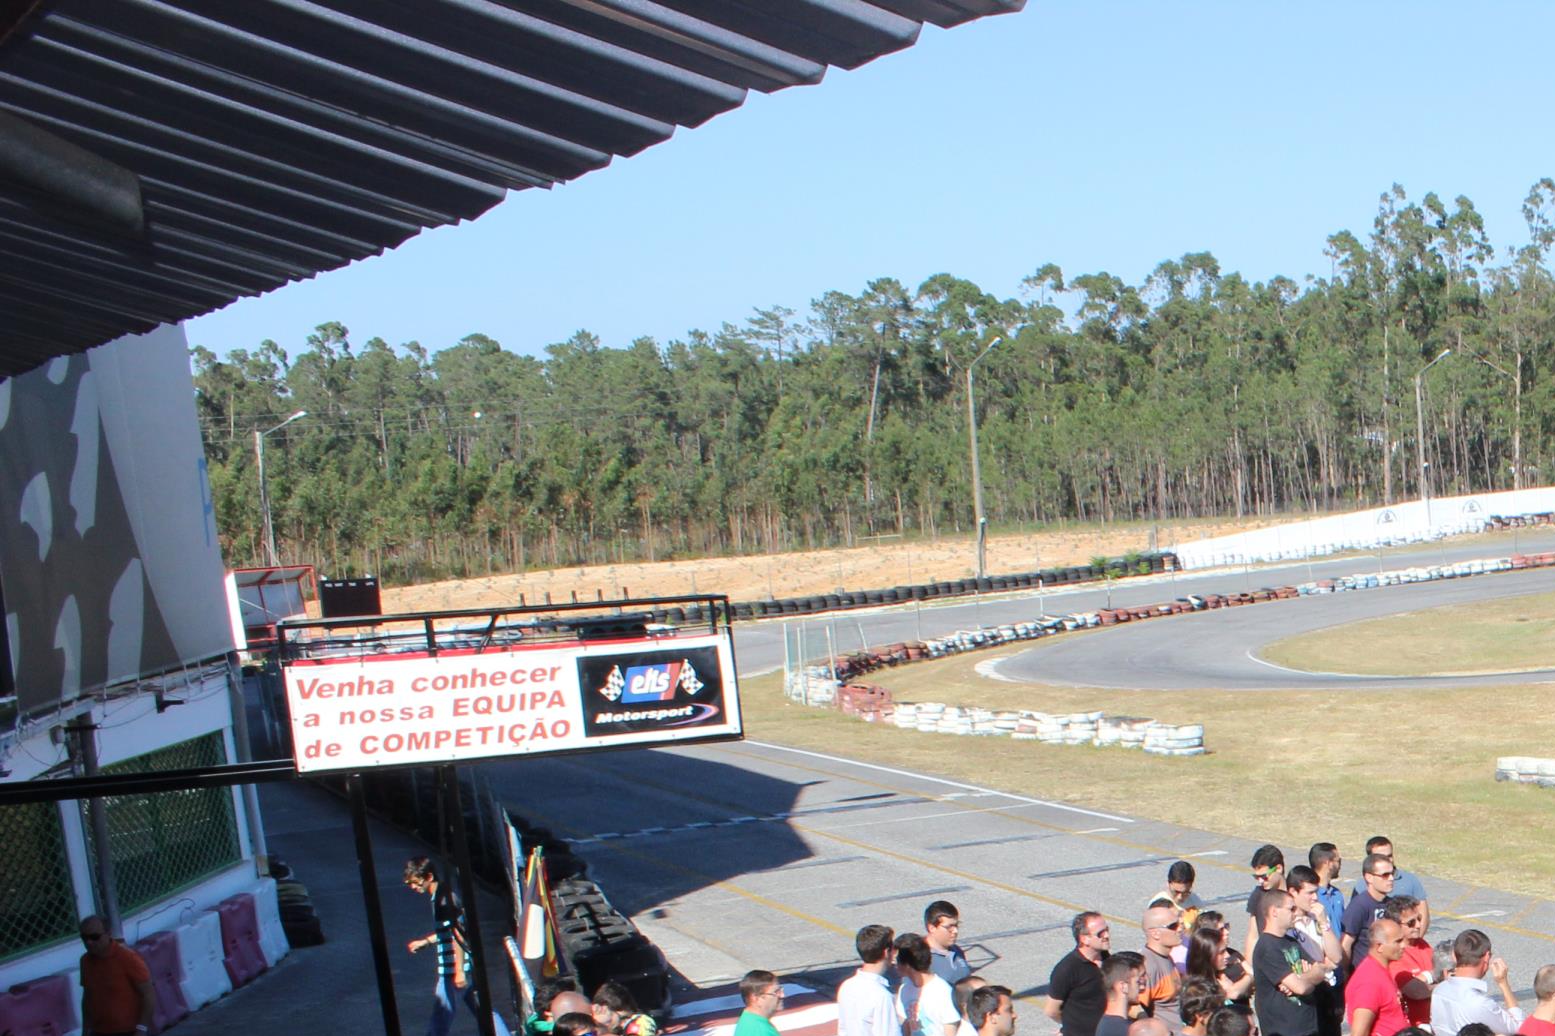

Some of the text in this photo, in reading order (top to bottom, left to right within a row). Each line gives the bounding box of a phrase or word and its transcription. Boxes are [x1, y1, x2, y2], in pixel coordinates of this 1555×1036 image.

[296, 665, 562, 700] Venha conhecer
[303, 689, 566, 728] a nossa EQUIPA
[595, 705, 694, 724] Motorsport
[304, 717, 571, 759] de COMPETIÇÃO
